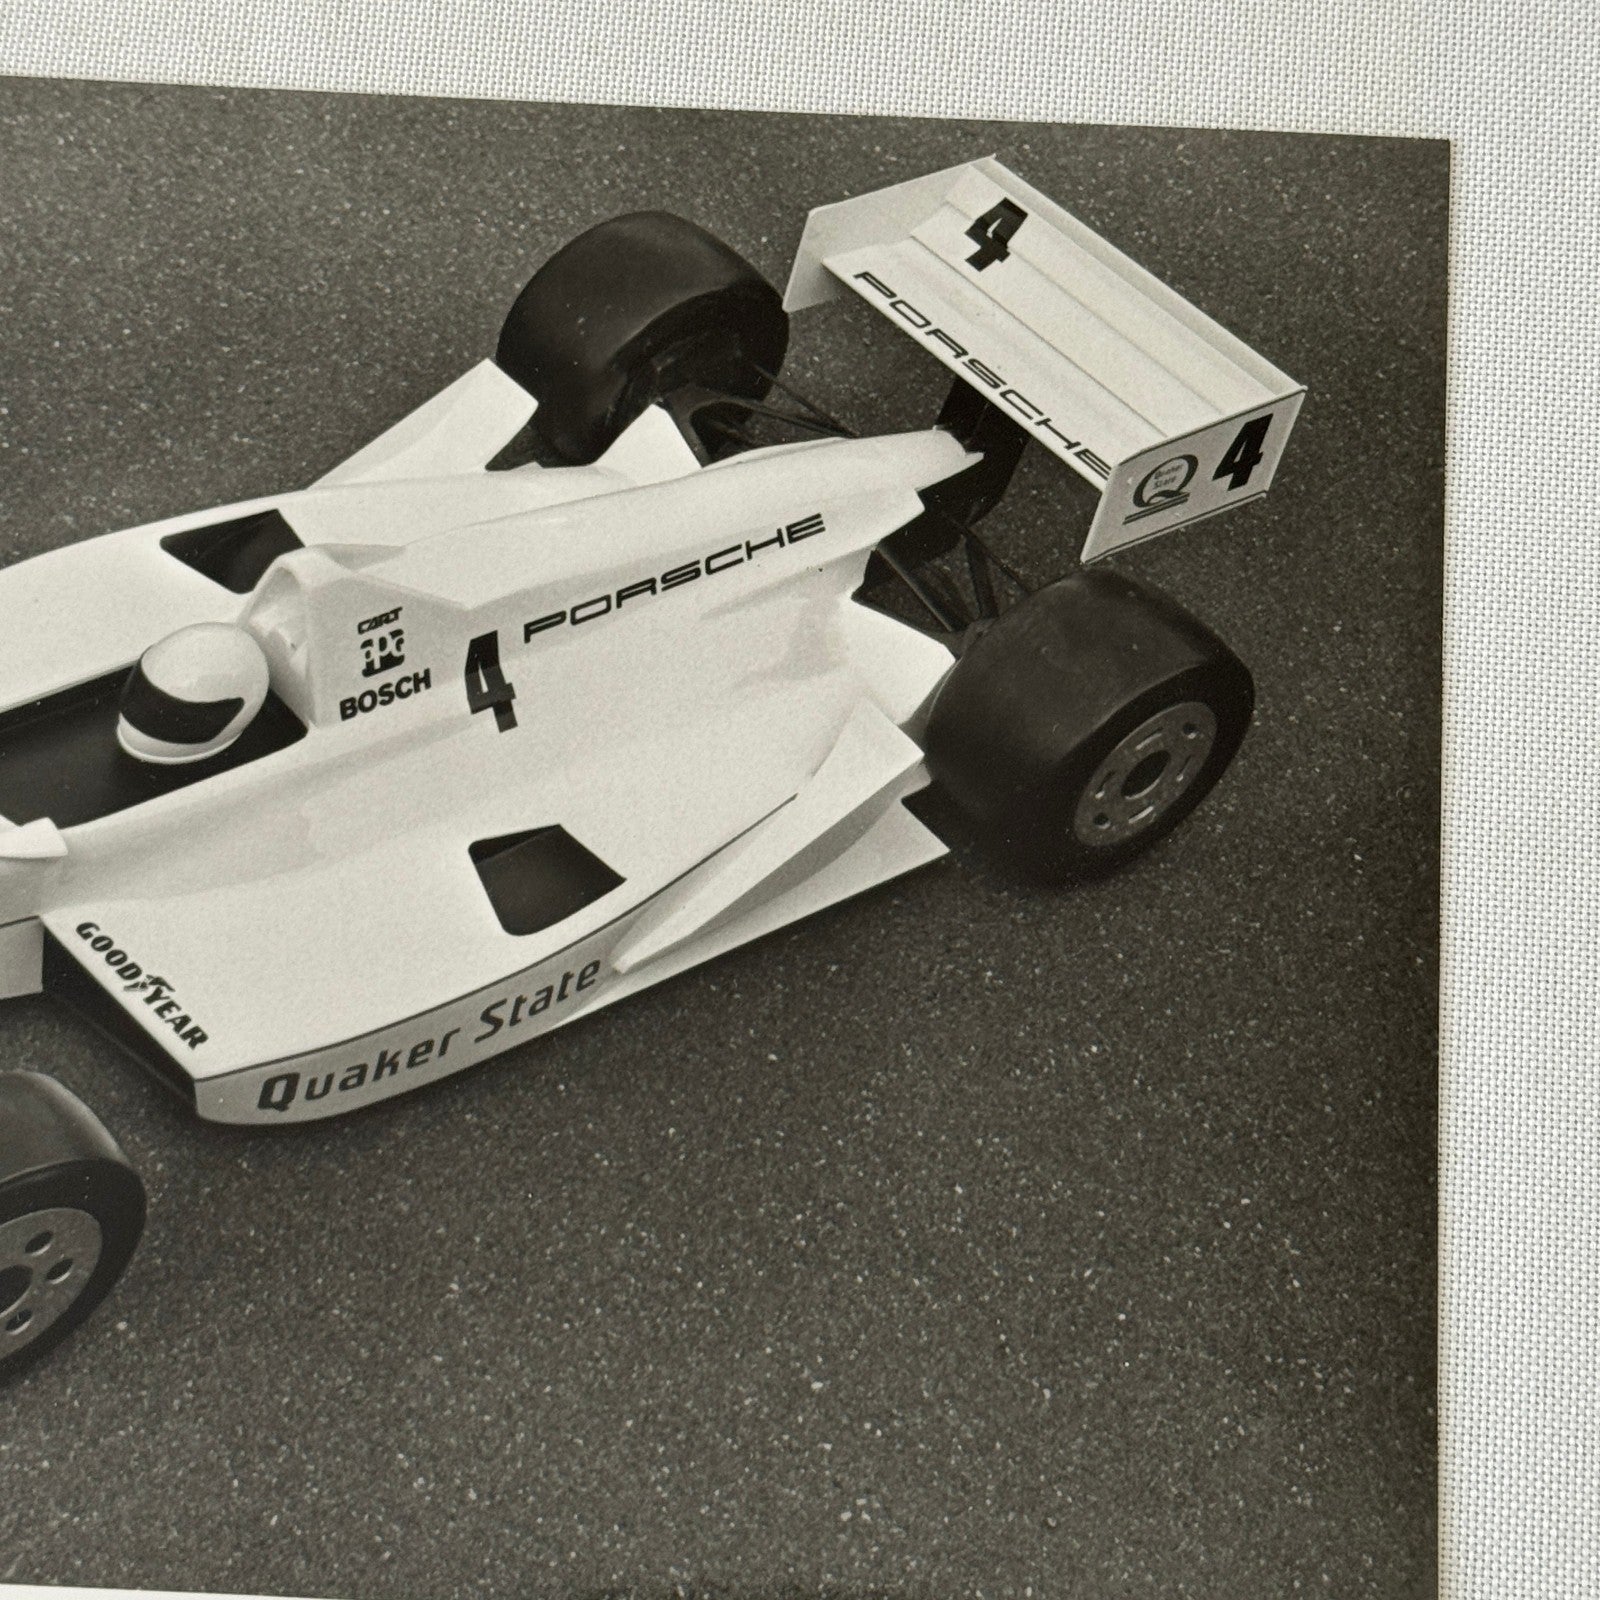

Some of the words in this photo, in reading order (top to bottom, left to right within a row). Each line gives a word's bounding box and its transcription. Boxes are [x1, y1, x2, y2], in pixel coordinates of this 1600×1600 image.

[964, 197, 1028, 272] 4
[853, 271, 1112, 481] PORSCHE
[1212, 413, 1274, 491] 4
[357, 606, 403, 635] CART
[524, 513, 825, 644] PORSCHE
[339, 668, 432, 721] BOSCH
[464, 630, 518, 734] 4
[76, 922, 209, 1050] GOODYEAR
[257, 1027, 461, 1113] Quaker
[474, 959, 601, 1044] State
